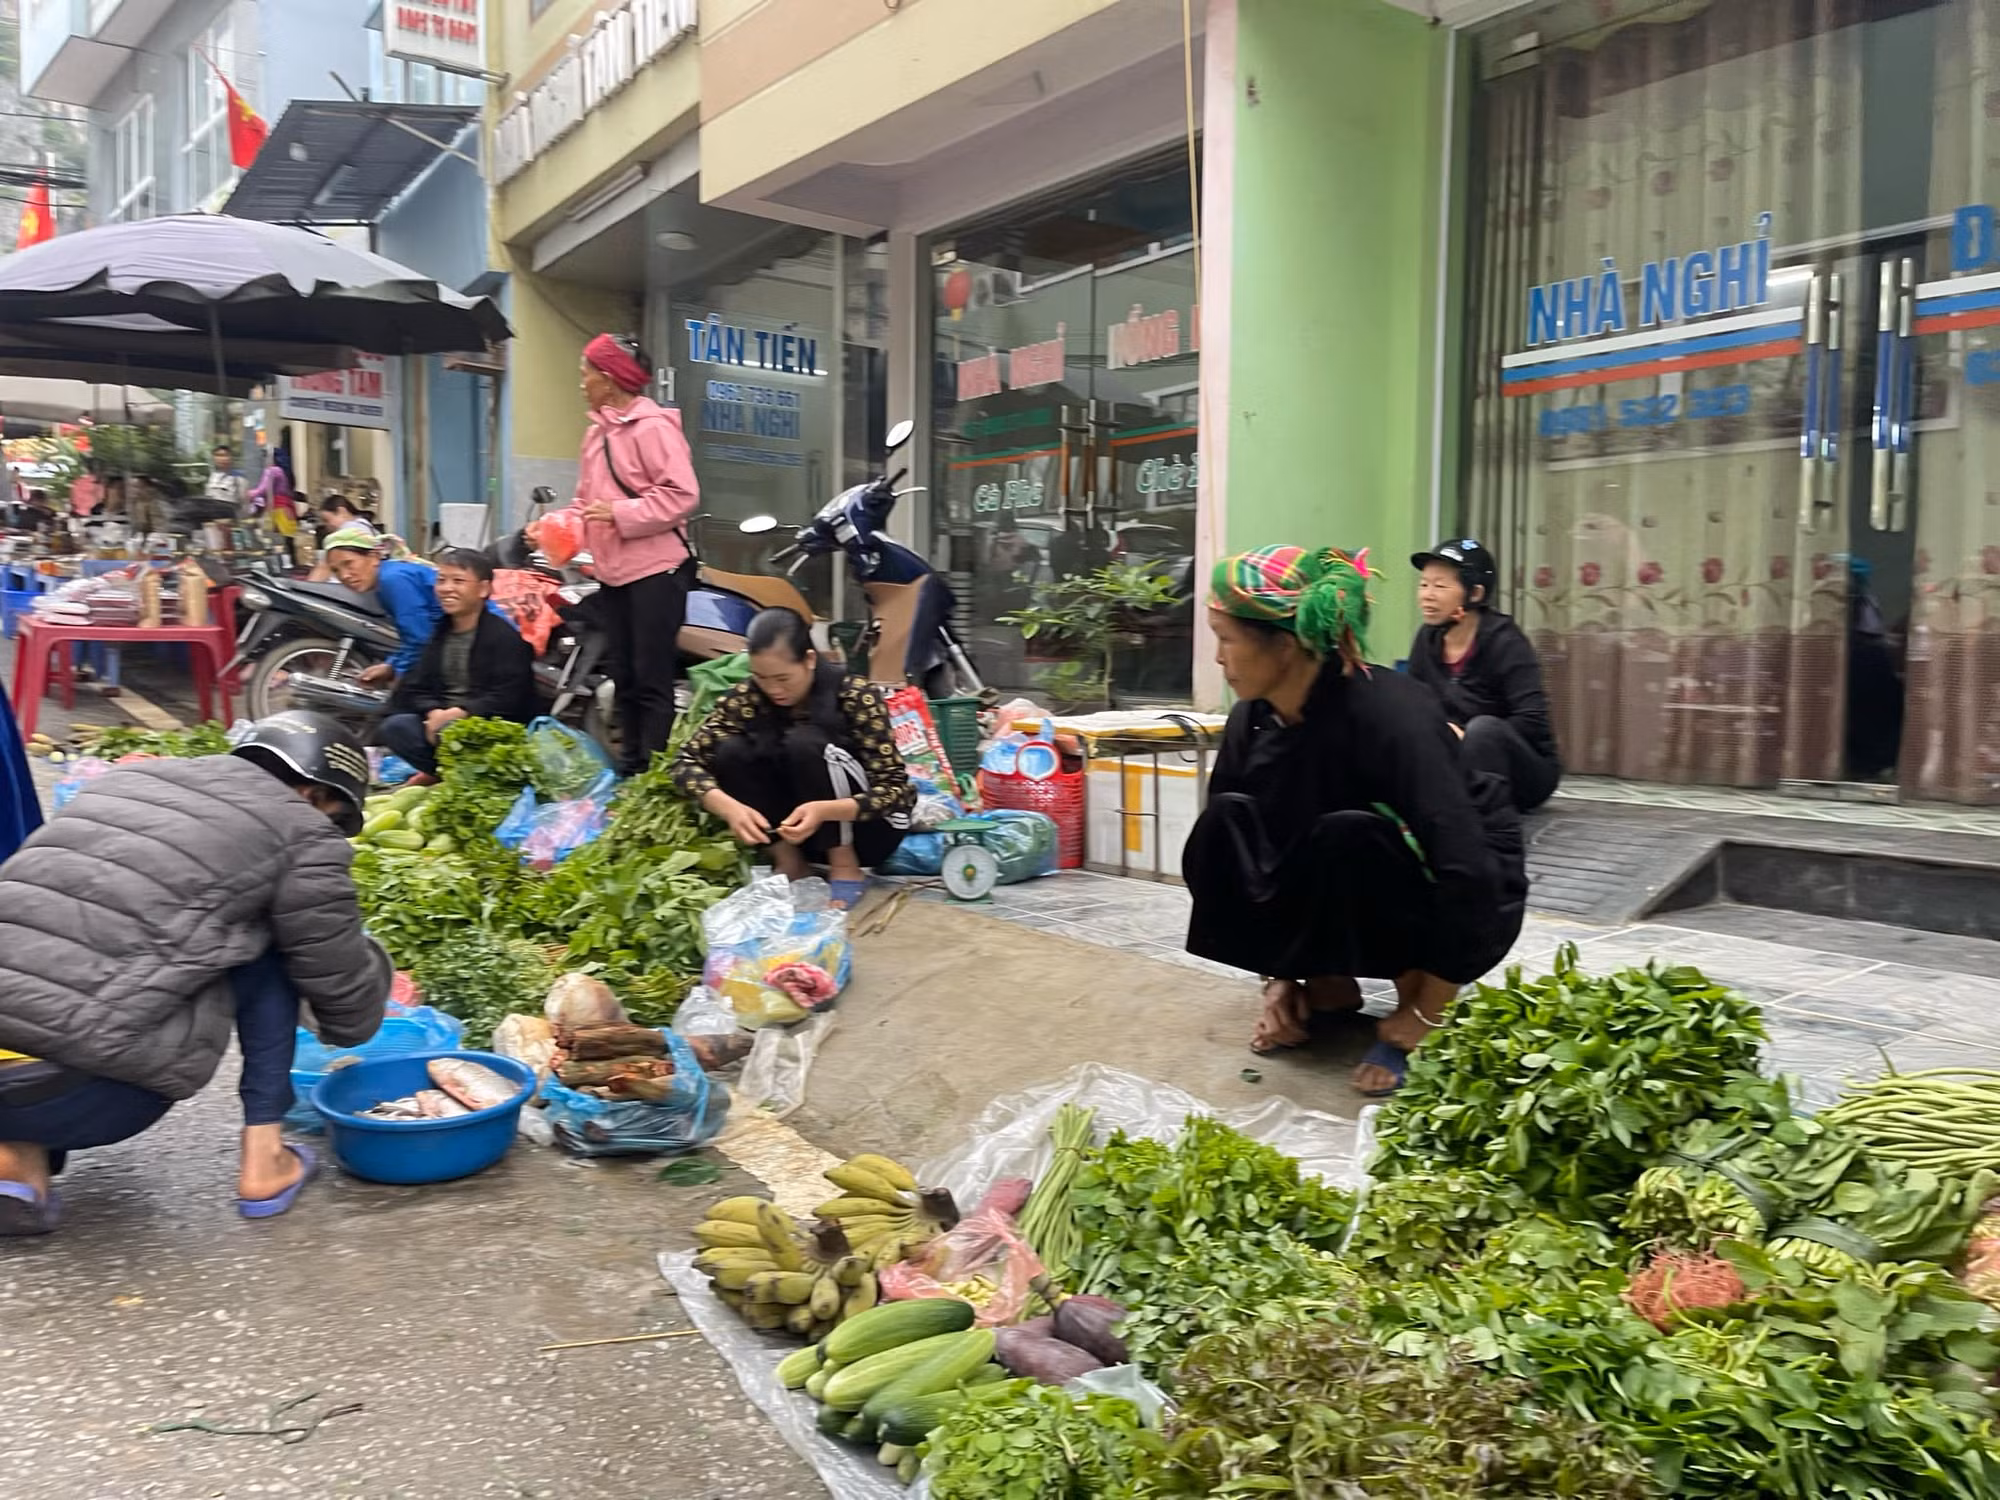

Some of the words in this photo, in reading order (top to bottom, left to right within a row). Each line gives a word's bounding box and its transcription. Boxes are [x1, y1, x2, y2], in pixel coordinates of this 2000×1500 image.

[1527, 256, 1626, 347] NHÀ
[1639, 211, 1773, 328] NGHỈ
[684, 312, 746, 366] TÂN
[753, 322, 818, 377] TIẾN
